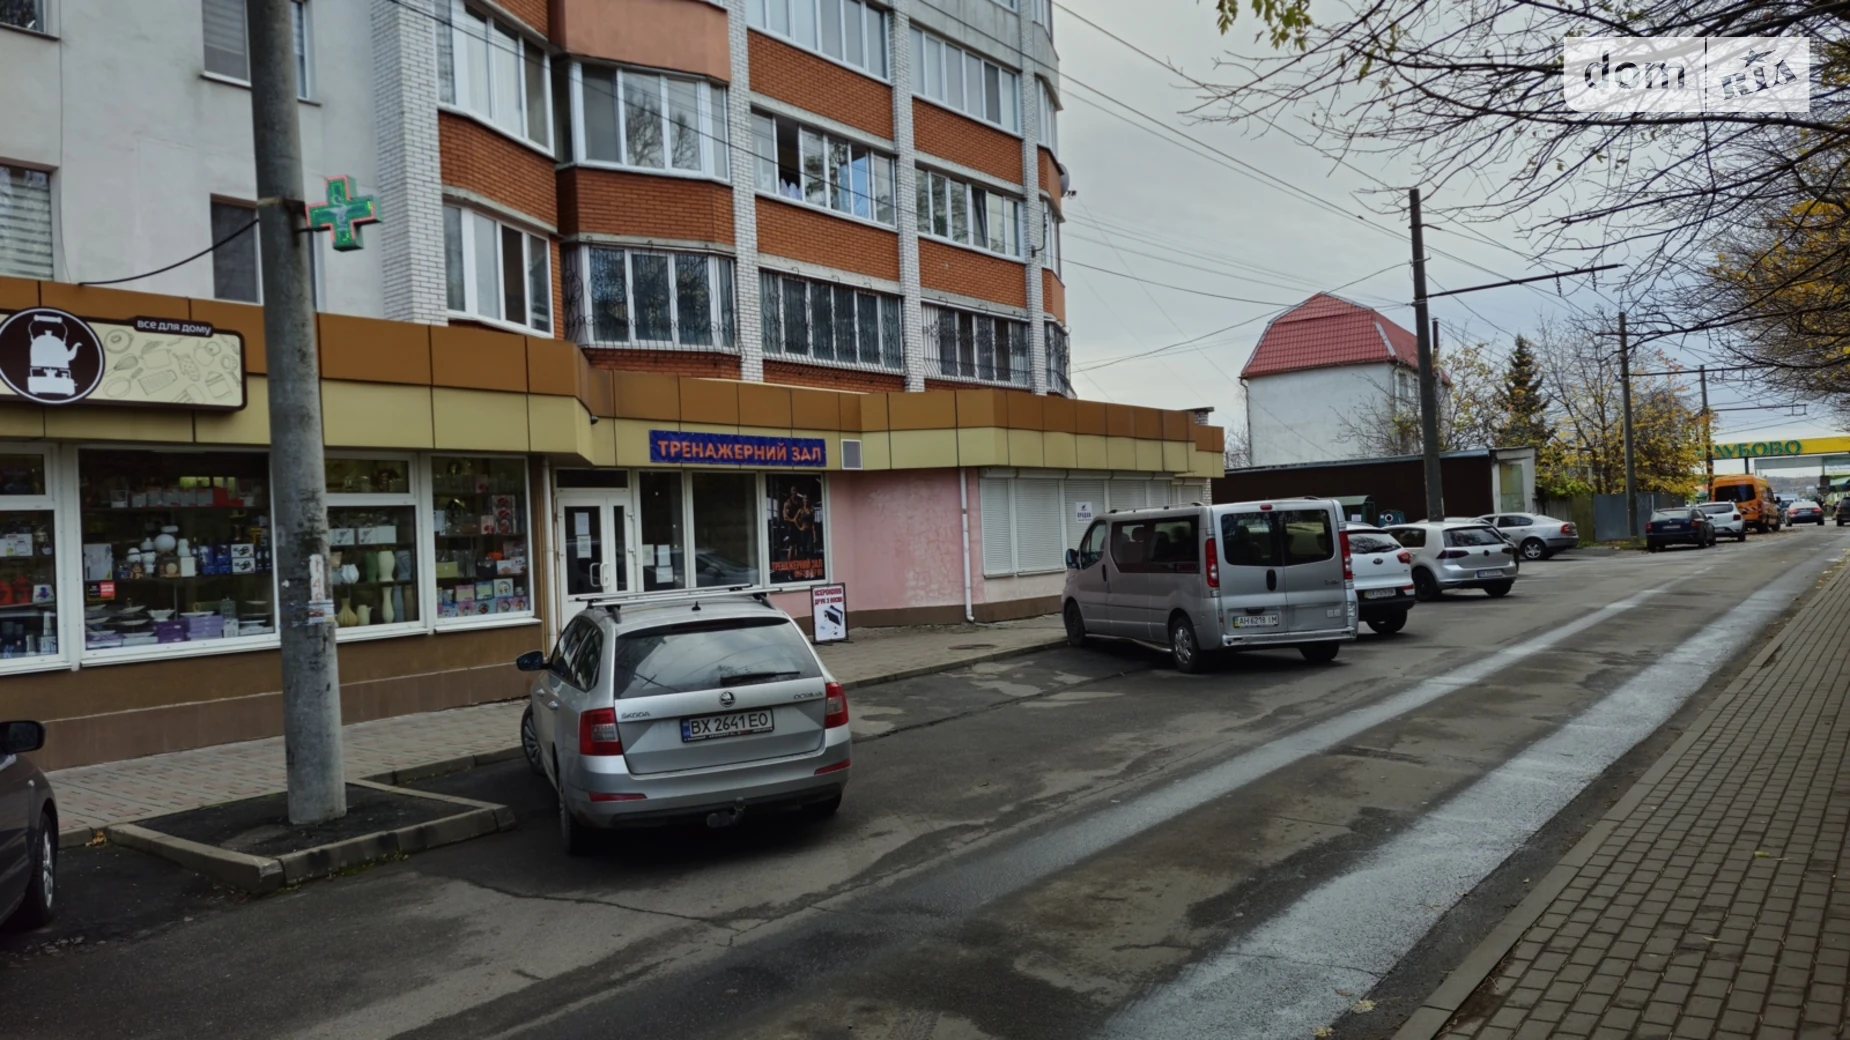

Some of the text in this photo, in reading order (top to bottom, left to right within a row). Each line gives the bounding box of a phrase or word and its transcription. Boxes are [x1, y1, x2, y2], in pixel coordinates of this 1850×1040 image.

[158, 322, 180, 331] для
[181, 324, 212, 336] дому
[657, 439, 822, 462] ТРЕНАЖЕРНИЙ ЗАЛ
[690, 719, 712, 735] BX
[714, 715, 747, 733] 2641
[749, 712, 768, 729] EO
